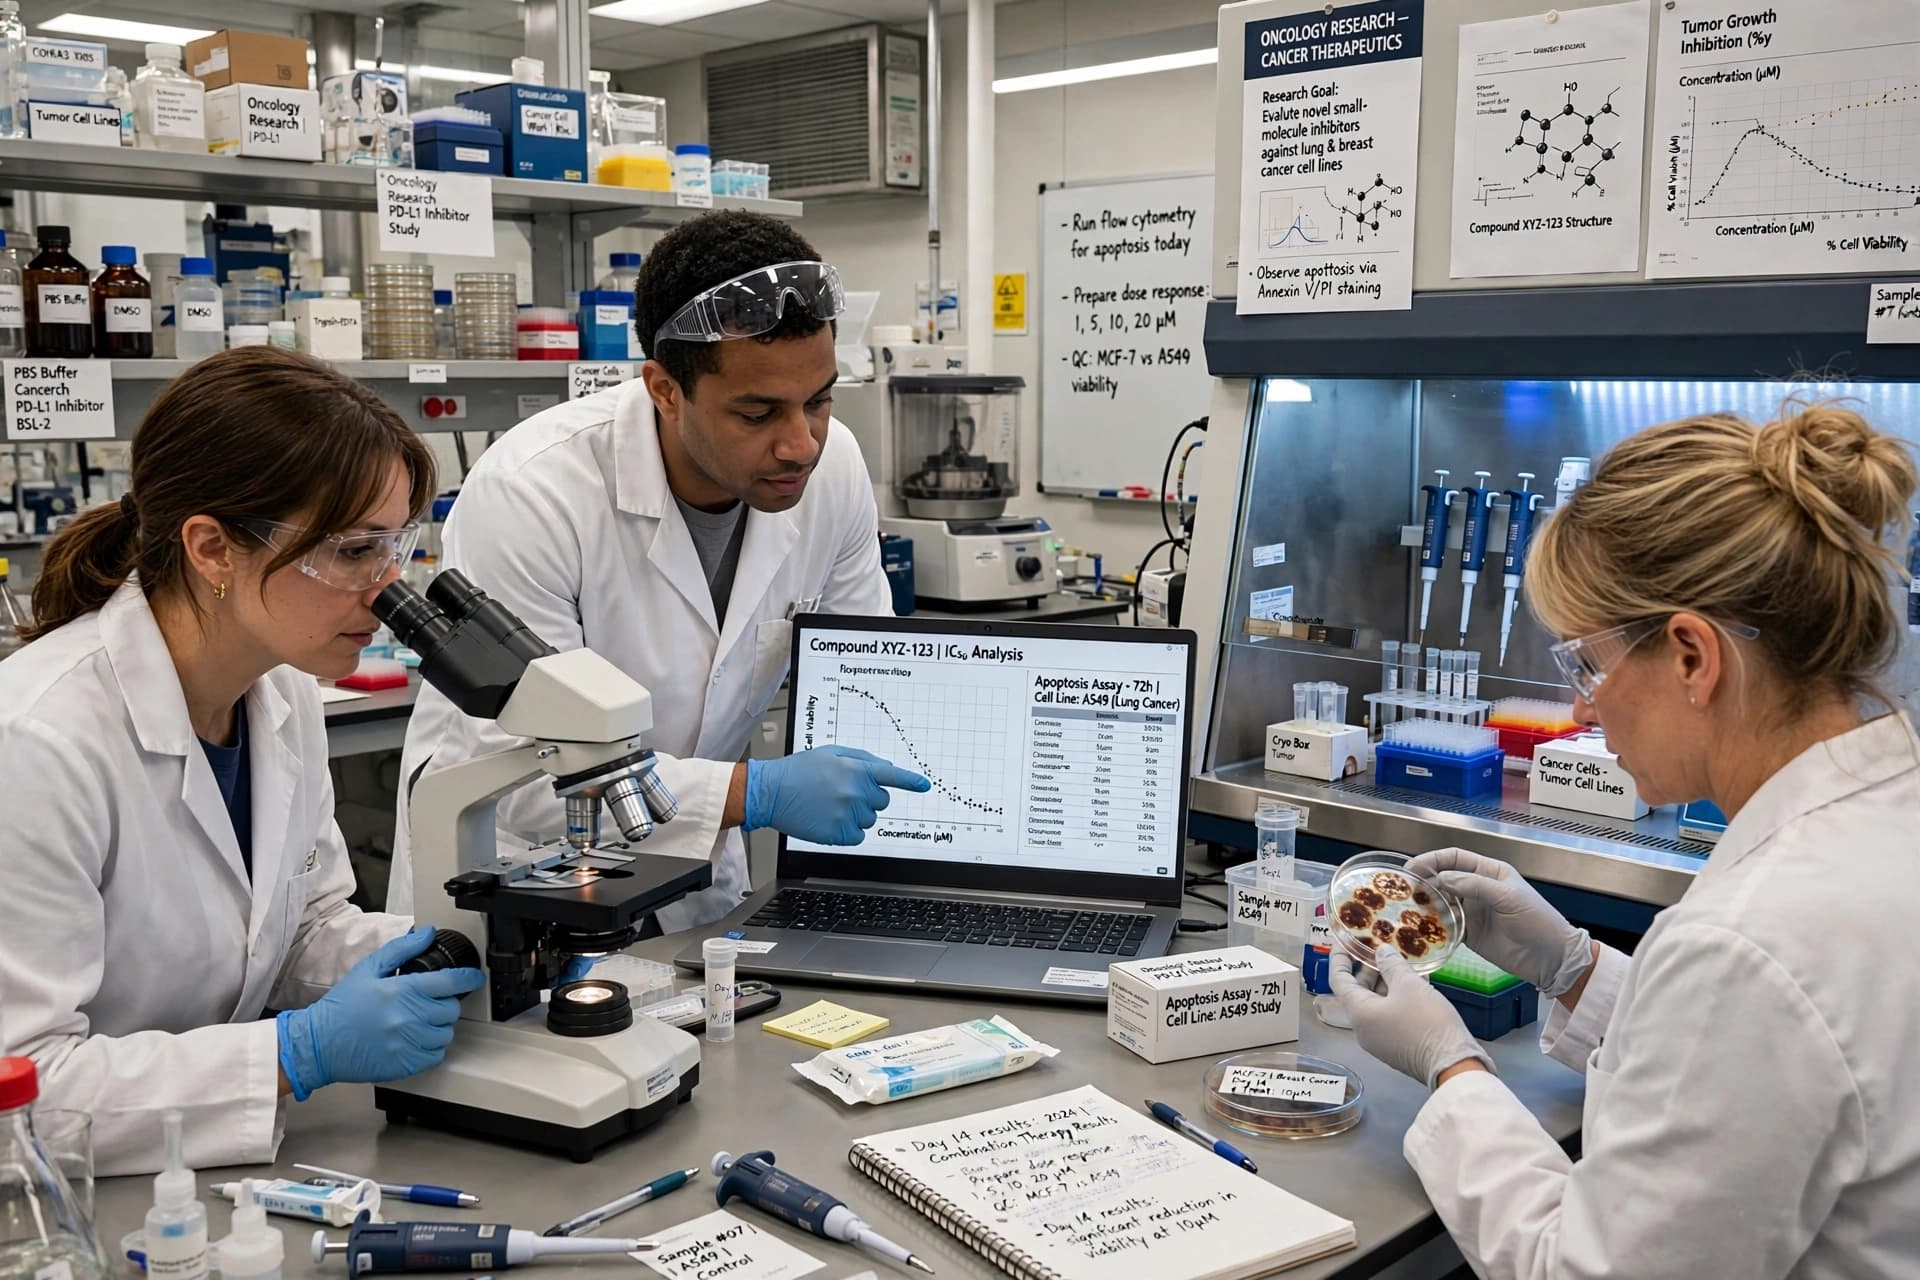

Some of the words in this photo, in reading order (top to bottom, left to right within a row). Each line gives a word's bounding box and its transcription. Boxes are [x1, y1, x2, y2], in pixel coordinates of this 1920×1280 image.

[1261, 22, 1327, 46] ONCOLOGY
[1331, 12, 1395, 36] RESEARCH
[1681, 17, 1723, 34] Tumor
[1727, 8, 1776, 29] Growth
[1261, 47, 1308, 67] CANCER
[1311, 33, 1402, 60] THERAPEUTICS
[1681, 35, 1743, 55] Inhibition
[1679, 68, 1752, 87] Concentration
[1262, 86, 1308, 104] Research
[1311, 82, 1338, 97] Goal:
[247, 97, 300, 115] Oncology
[1262, 107, 1299, 122] Evalute
[1302, 102, 1331, 118] novel
[1334, 98, 1367, 114] small-
[36, 109, 70, 122] Tumor
[73, 112, 91, 125] Cell
[93, 113, 120, 127] Lines
[249, 114, 299, 129] Research
[1261, 123, 1308, 141] molecule
[1310, 120, 1360, 136] inhibitors
[1261, 142, 1298, 162] against
[1301, 141, 1324, 157] lung
[1327, 139, 1335, 153] &
[1339, 136, 1373, 151] breast
[1261, 163, 1294, 177] cancer
[1297, 159, 1315, 174] cell
[1318, 158, 1343, 173] lines
[387, 175, 437, 192] Oncology
[388, 191, 436, 204] Research
[389, 205, 420, 219] PD-L1
[425, 208, 469, 221] Inhibitor
[1073, 213, 1096, 231] Run
[1101, 210, 1127, 229] flow
[1132, 206, 1196, 231] cytometry
[389, 222, 420, 238] Study
[1470, 220, 1519, 235] Compound
[1522, 218, 1562, 230] XYZ-123
[1566, 216, 1612, 228] Structure
[1716, 222, 1787, 236] Concentration
[1071, 239, 1089, 259] for
[1094, 237, 1150, 262] apoptosis
[1155, 232, 1191, 256] today
[1827, 240, 1836, 250] %
[1840, 237, 1859, 249] Cell
[1862, 235, 1908, 252] Viability
[1257, 266, 1300, 280] Observe
[1360, 261, 1377, 274] via
[1074, 286, 1117, 308] Prepare
[1122, 283, 1147, 300] dose
[1152, 285, 1209, 305] response:
[1258, 284, 1299, 299] Annexin
[1306, 280, 1332, 299] V/PI
[1337, 280, 1381, 299] staining
[1876, 287, 1920, 304] Sample
[114, 306, 140, 315] DMSO
[1091, 314, 1102, 334] 5,
[1110, 314, 1128, 333] 10,
[1134, 313, 1150, 328] 20
[1072, 350, 1092, 368] QC:
[1097, 349, 1136, 366] MCF-7
[1141, 354, 1152, 365] vs
[1158, 347, 1191, 365] A549
[14, 367, 37, 379] PBS
[41, 366, 77, 379] Buffer
[15, 383, 70, 396] Cancerch
[1072, 374, 1118, 400] viability
[16, 400, 50, 413] PD-L1
[55, 400, 105, 413] Inhibitor
[17, 418, 51, 430] BSL-2
[810, 638, 878, 655] Compound
[881, 641, 934, 657] XYZ-123
[972, 645, 1023, 663] Analysis
[1035, 675, 1088, 690] Apoptosis
[1092, 679, 1123, 694] Assay
[1133, 680, 1152, 692] 72h
[1035, 692, 1053, 703] Cell
[1056, 693, 1079, 704] Line:
[1082, 694, 1108, 705] A549
[1111, 695, 1139, 711] (Lung
[1142, 697, 1180, 712] Cancer)
[806, 695, 818, 731] Viability
[805, 733, 813, 751] Cell
[1272, 735, 1291, 749] Cryo
[1294, 738, 1310, 749] Box
[1272, 749, 1295, 760] Tumor
[1540, 756, 1573, 771] Cancer
[1576, 762, 1601, 776] Cells
[1539, 771, 1572, 786] Tumor
[1575, 777, 1593, 790] Cell
[1597, 781, 1624, 795] Lines
[877, 828, 931, 841] Concentration
[1238, 891, 1270, 909] Sample
[1274, 900, 1292, 912] #07
[1165, 990, 1219, 1012] Apoptosis
[1222, 988, 1252, 1002] Assay
[1261, 982, 1280, 996] 72h
[1166, 1011, 1188, 1027] Cell
[1191, 1010, 1217, 1024] Line:
[1220, 1003, 1248, 1020] A549
[1251, 998, 1281, 1015] Study
[1276, 1073, 1305, 1082] Breast
[912, 1138, 947, 1152] Day
[952, 1130, 970, 1143] 14
[980, 1118, 1038, 1138] results:
[1044, 1108, 1076, 1123] 2024
[930, 1139, 1018, 1164] Combination
[1019, 1127, 1074, 1145] Therapy
[1072, 1115, 1118, 1132] Results
[1067, 1215, 1140, 1246] significant
[1149, 1198, 1216, 1222] reduction
[1218, 1191, 1237, 1201] in
[1044, 1223, 1075, 1236] Day
[658, 1240, 714, 1264] Sample
[716, 1225, 744, 1242] #07
[1084, 1236, 1149, 1258] viability
[1154, 1226, 1171, 1241] at
[680, 1251, 719, 1271] A549
[697, 1254, 753, 1280] Control
